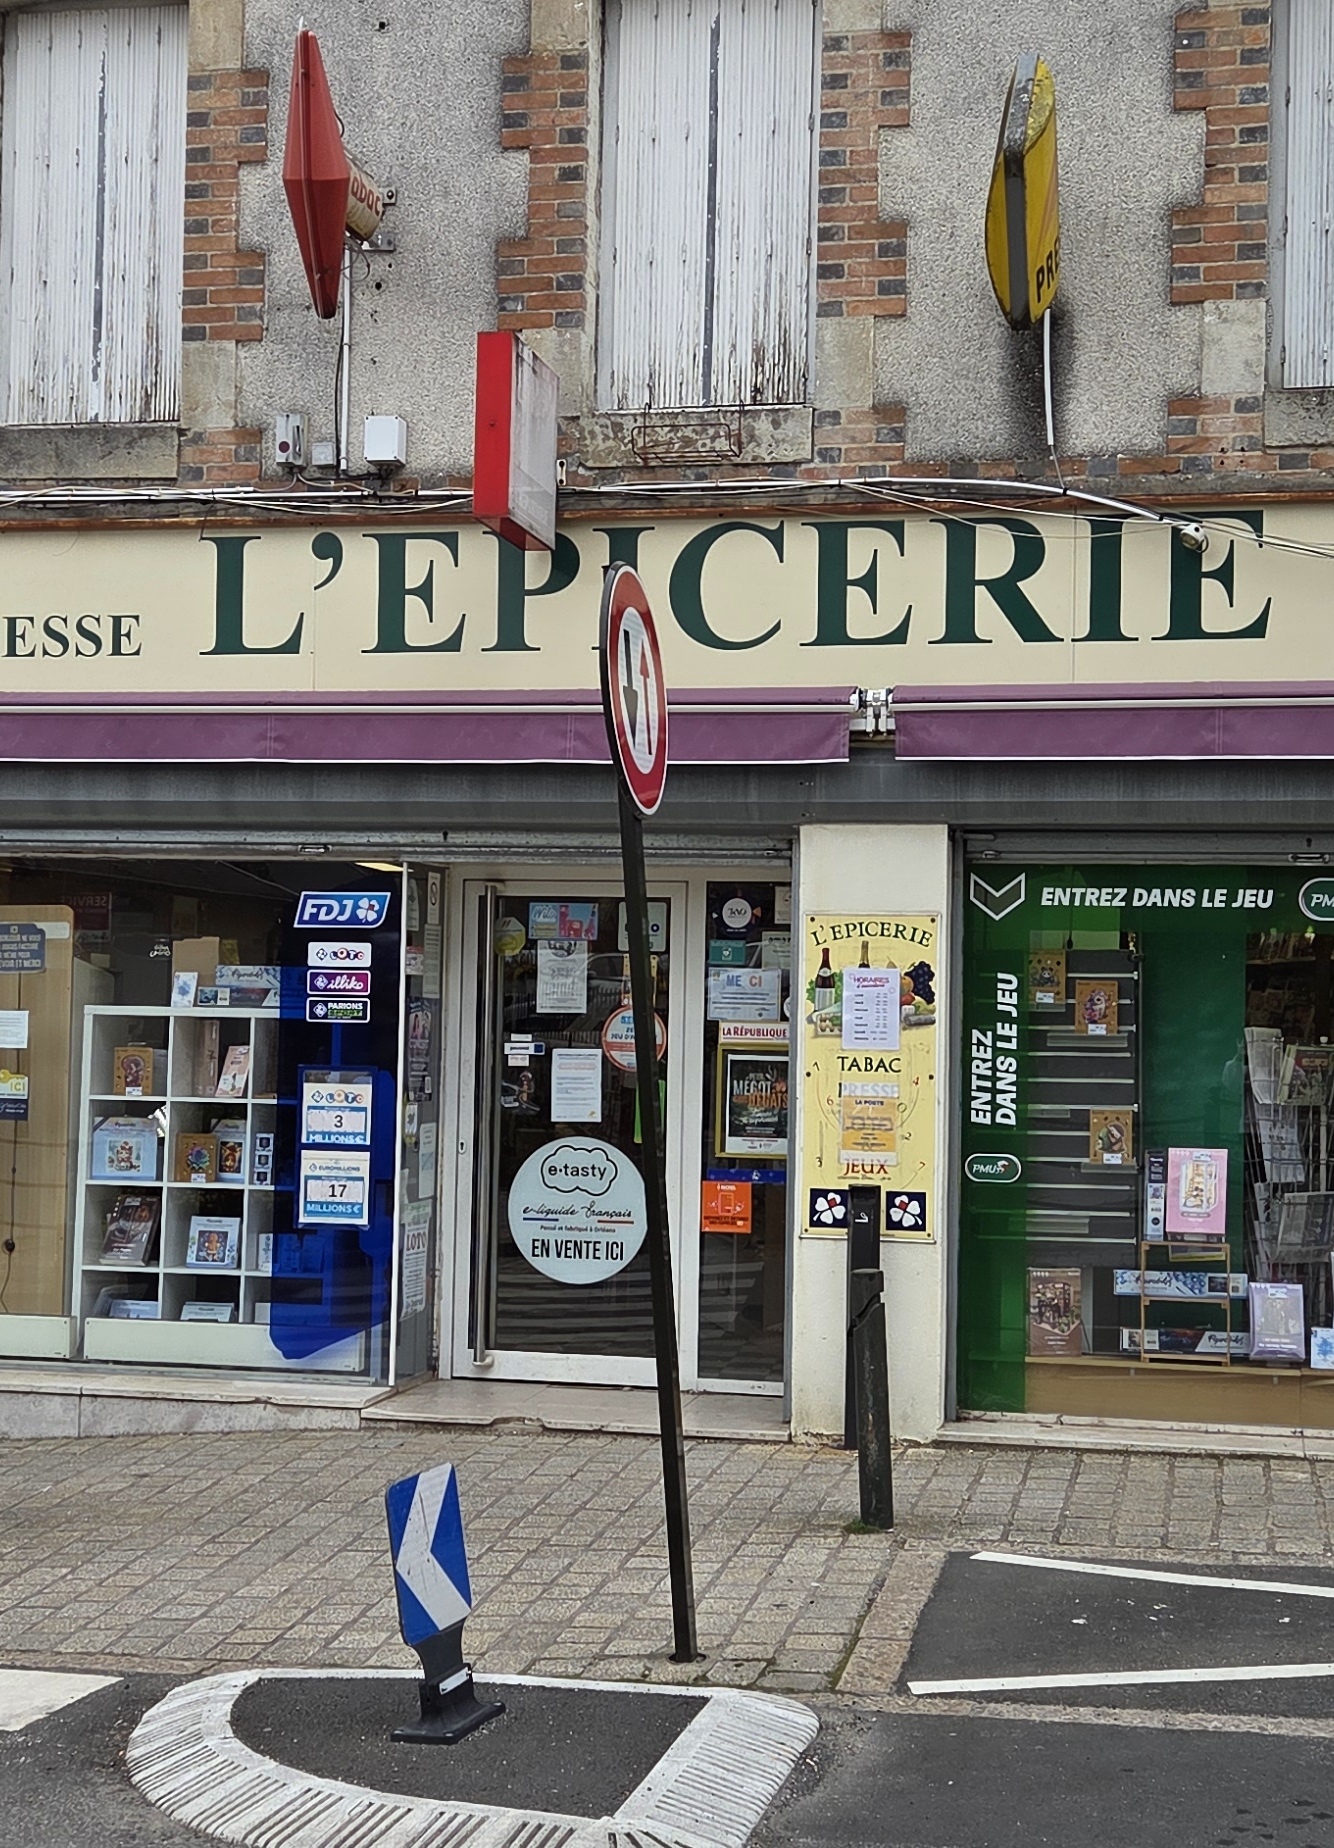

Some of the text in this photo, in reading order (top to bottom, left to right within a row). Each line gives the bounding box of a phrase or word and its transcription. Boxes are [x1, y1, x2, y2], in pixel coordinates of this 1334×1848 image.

[1041, 887, 1274, 908] ENTREZ DANS LE JEU
[302, 898, 354, 922] FDJ
[810, 921, 933, 948] L'EPICERIE
[327, 974, 364, 990] illiko
[327, 1002, 364, 1010] PARIONS
[722, 1023, 787, 1038] LA RÉPUBLIQUE
[995, 972, 1019, 1126] DANS LE JEU
[836, 1055, 902, 1073] TABAC
[970, 1028, 993, 1126] ENTREZ
[10, 1082, 26, 1092] ICI
[333, 1114, 344, 1129] 3
[309, 1133, 354, 1143] MILLIONS
[843, 1157, 889, 1177] JEUX
[972, 1164, 998, 1174] PMU
[328, 1184, 348, 1198] 17
[306, 1202, 352, 1213] MILLIONS
[531, 1238, 624, 1261] EN VENTE ICI
